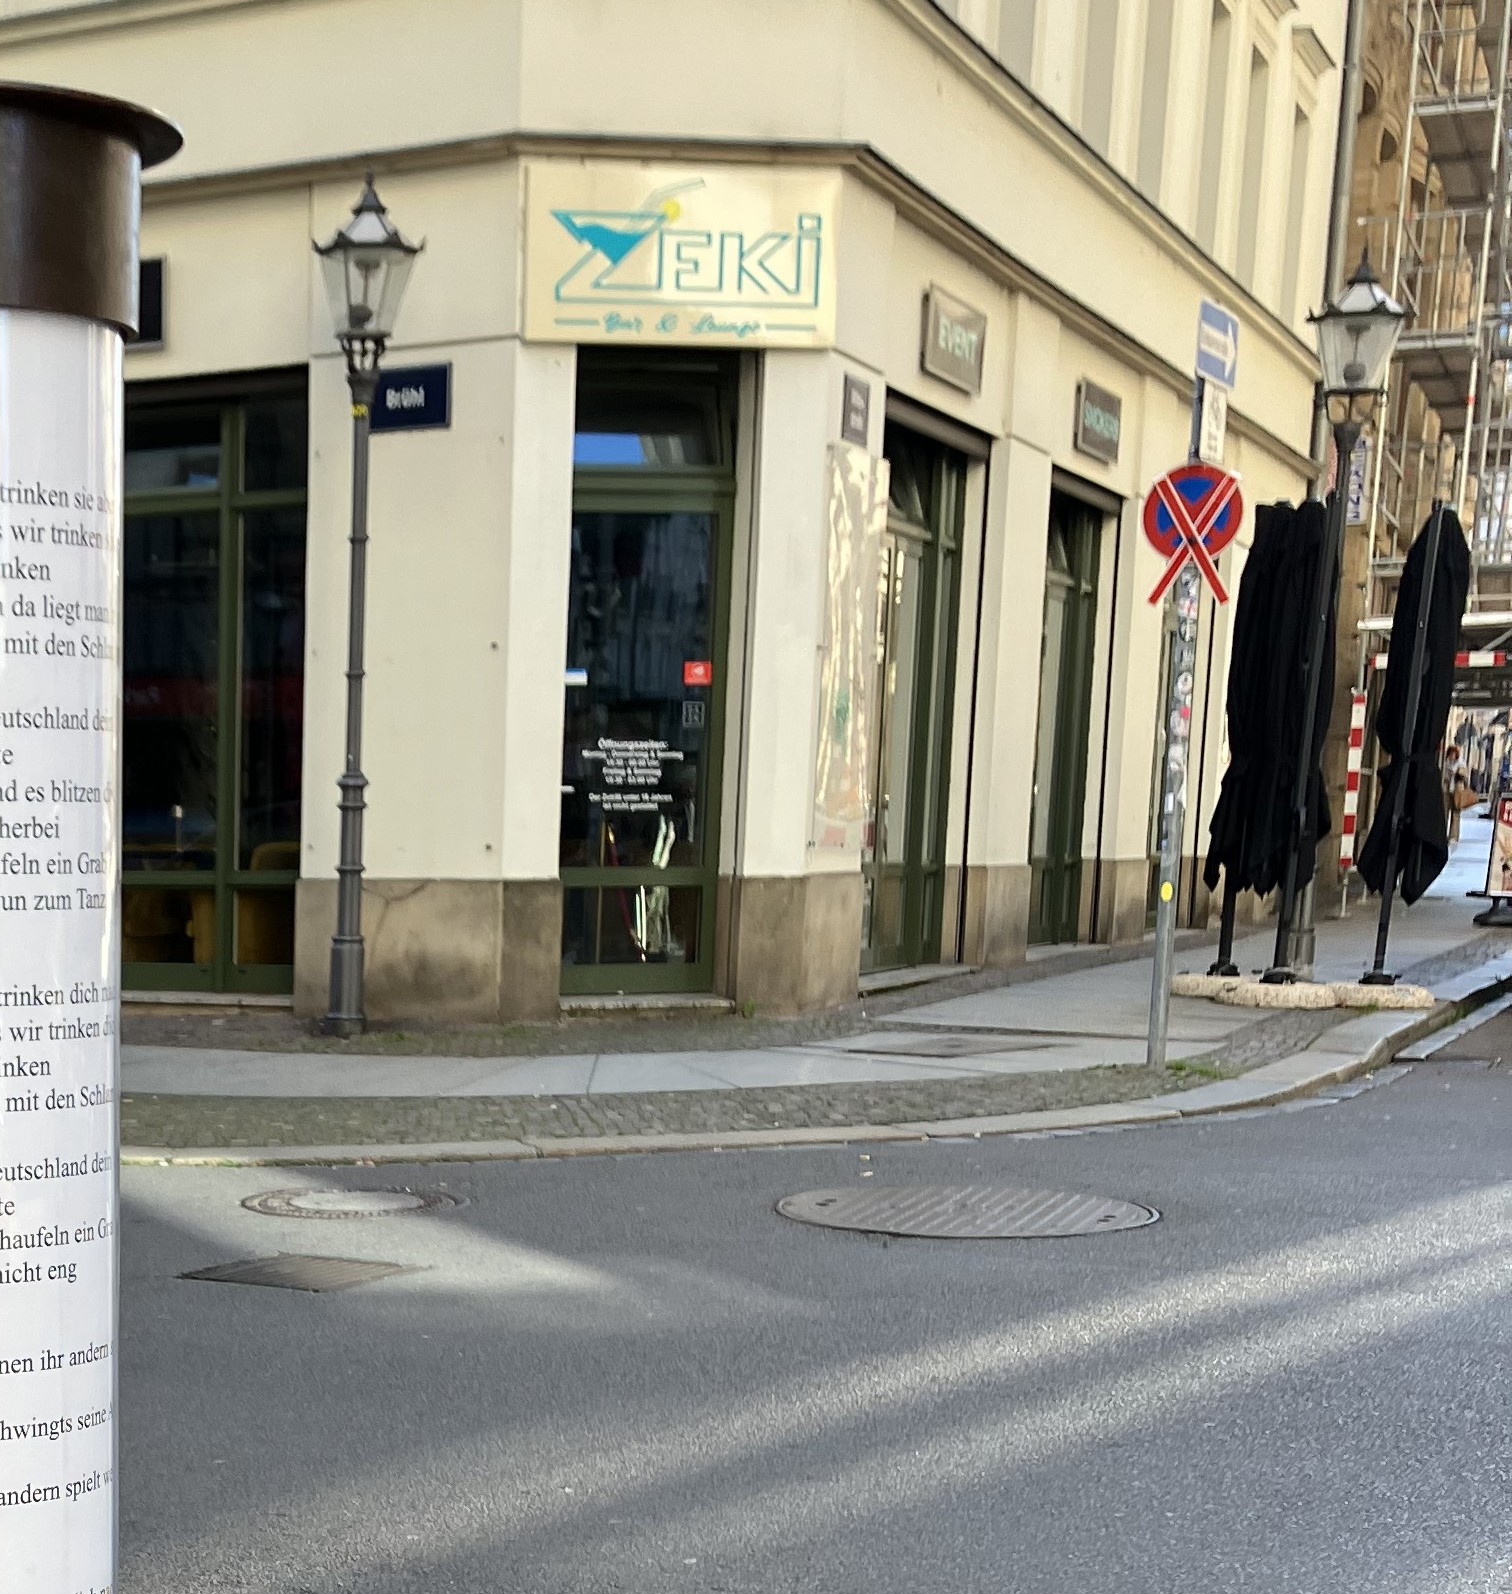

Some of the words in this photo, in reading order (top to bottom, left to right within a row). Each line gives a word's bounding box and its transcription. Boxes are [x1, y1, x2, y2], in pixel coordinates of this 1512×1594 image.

[940, 312, 979, 364] EVENT
[0, 481, 69, 509] trinken
[33, 895, 72, 910] zum
[70, 982, 99, 1004] dich
[74, 1227, 94, 1243] ein
[48, 1263, 77, 1283] eng
[40, 1349, 65, 1372] ihr
[69, 1342, 109, 1366] andern
[77, 1406, 106, 1430] seine
